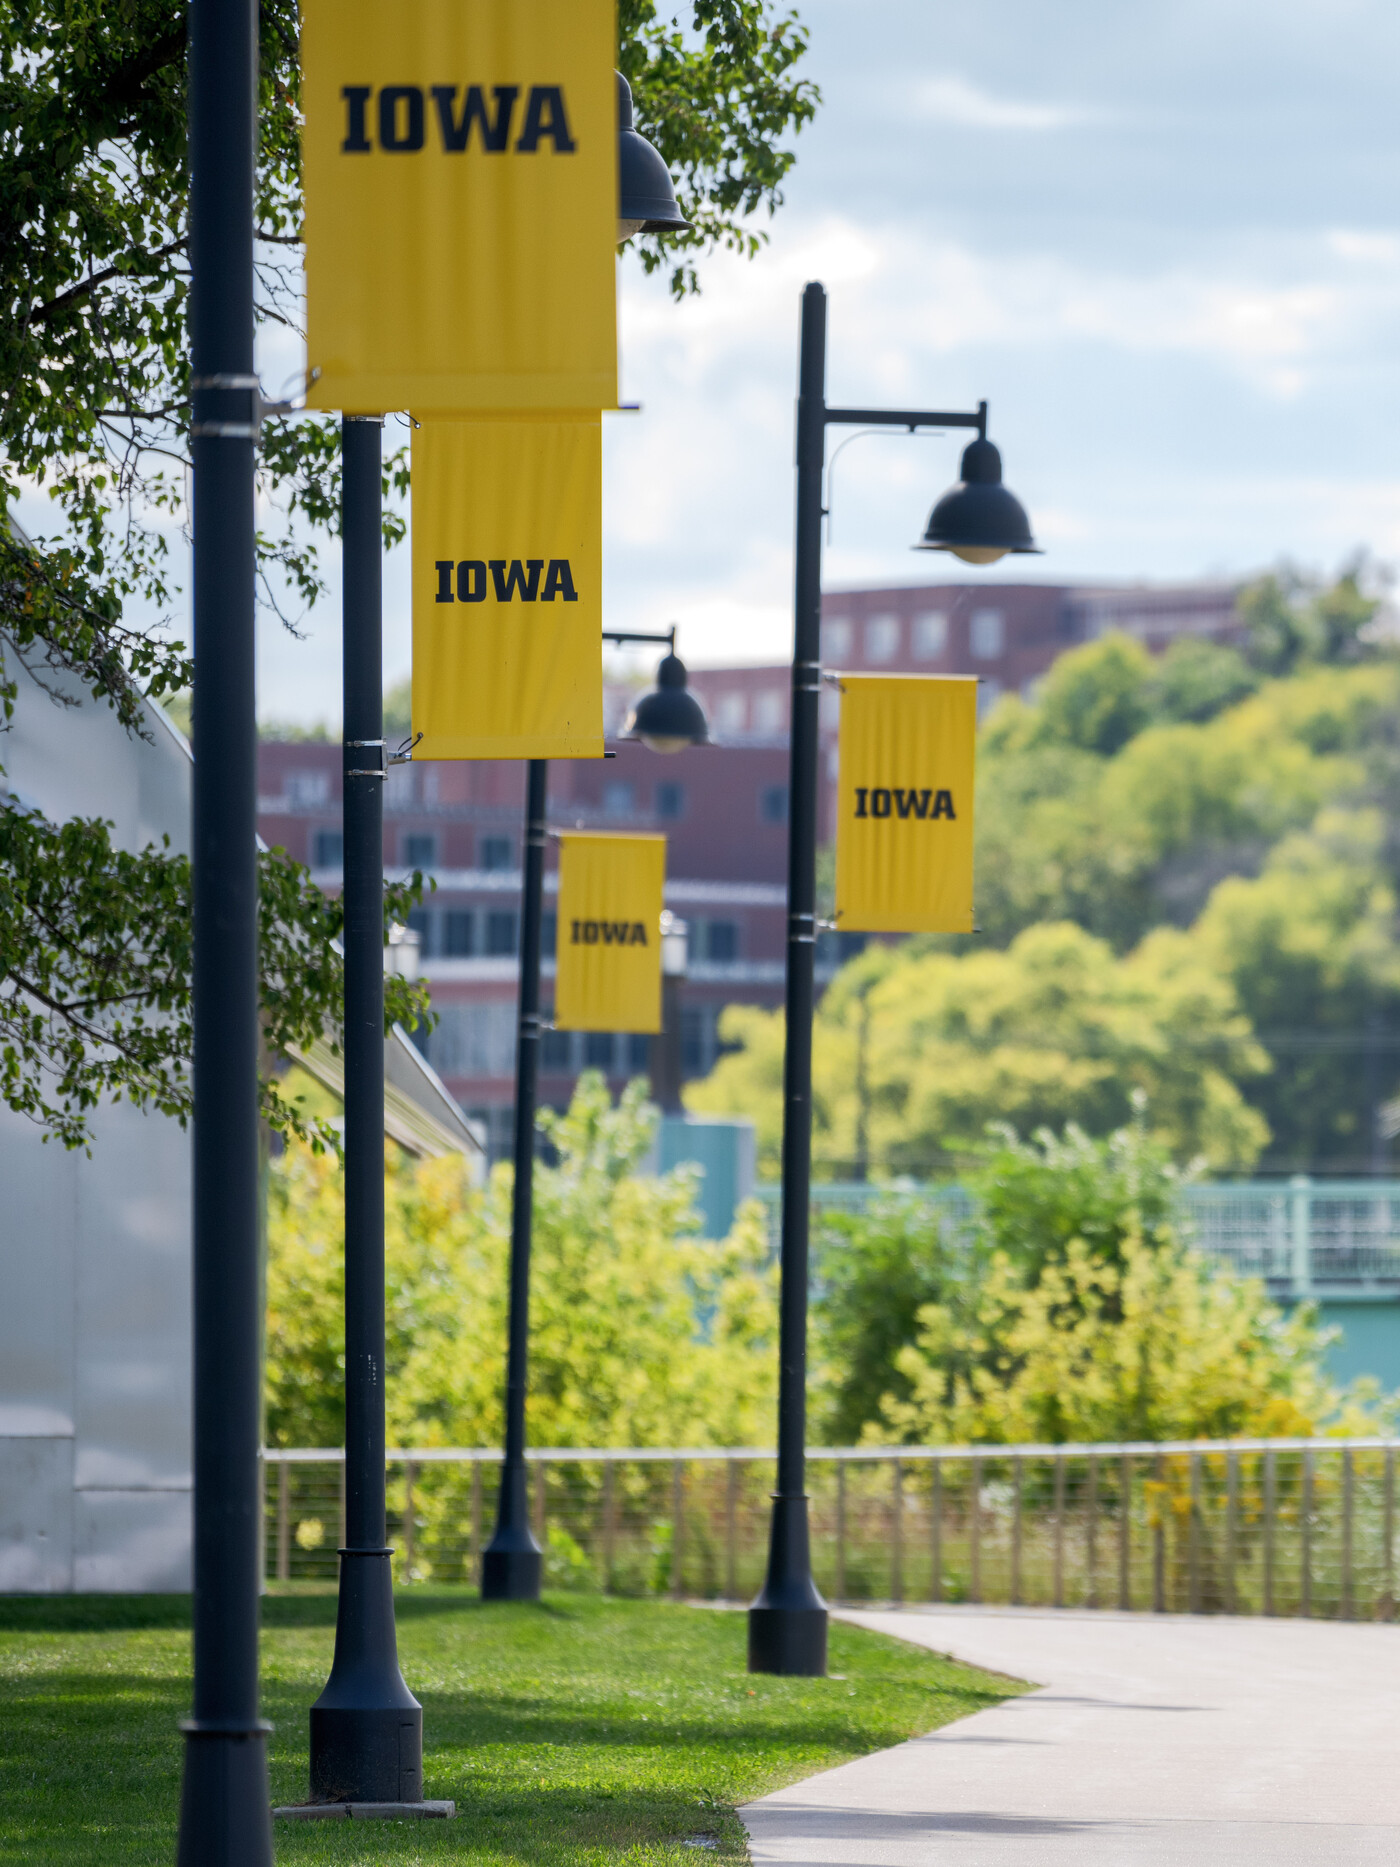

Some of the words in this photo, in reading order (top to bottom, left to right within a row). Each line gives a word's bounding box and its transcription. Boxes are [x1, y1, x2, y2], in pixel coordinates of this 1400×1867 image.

[341, 84, 578, 155] IOWA
[436, 561, 578, 603] IOWA
[854, 787, 957, 820] IOWA
[572, 921, 647, 945] IOWA
